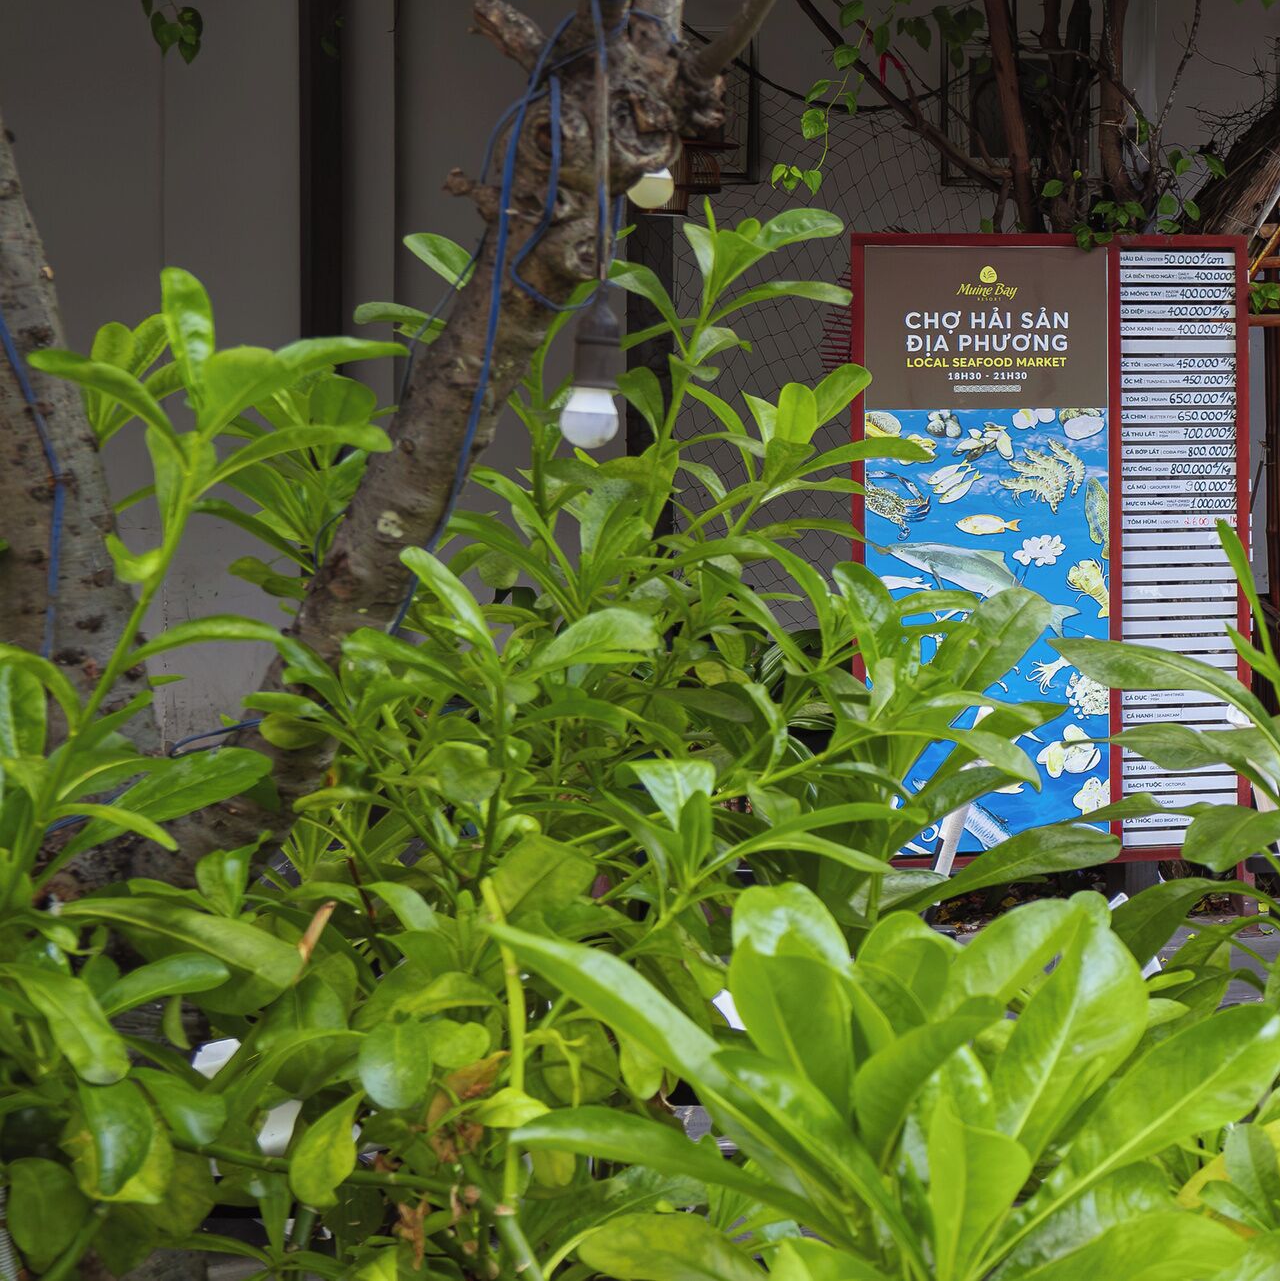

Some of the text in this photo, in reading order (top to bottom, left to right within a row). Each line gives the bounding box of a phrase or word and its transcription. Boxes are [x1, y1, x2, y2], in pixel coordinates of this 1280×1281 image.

[956, 282, 1018, 300] Muine Bay
[905, 307, 1069, 335] CHỢ HẢI SẢN
[906, 333, 1069, 357] ĐỊA PHƯƠNG
[906, 357, 1067, 368] LOCAL SEAFOOD MARKET
[948, 372, 982, 380] 18H30
[993, 372, 1028, 380] 21H30
